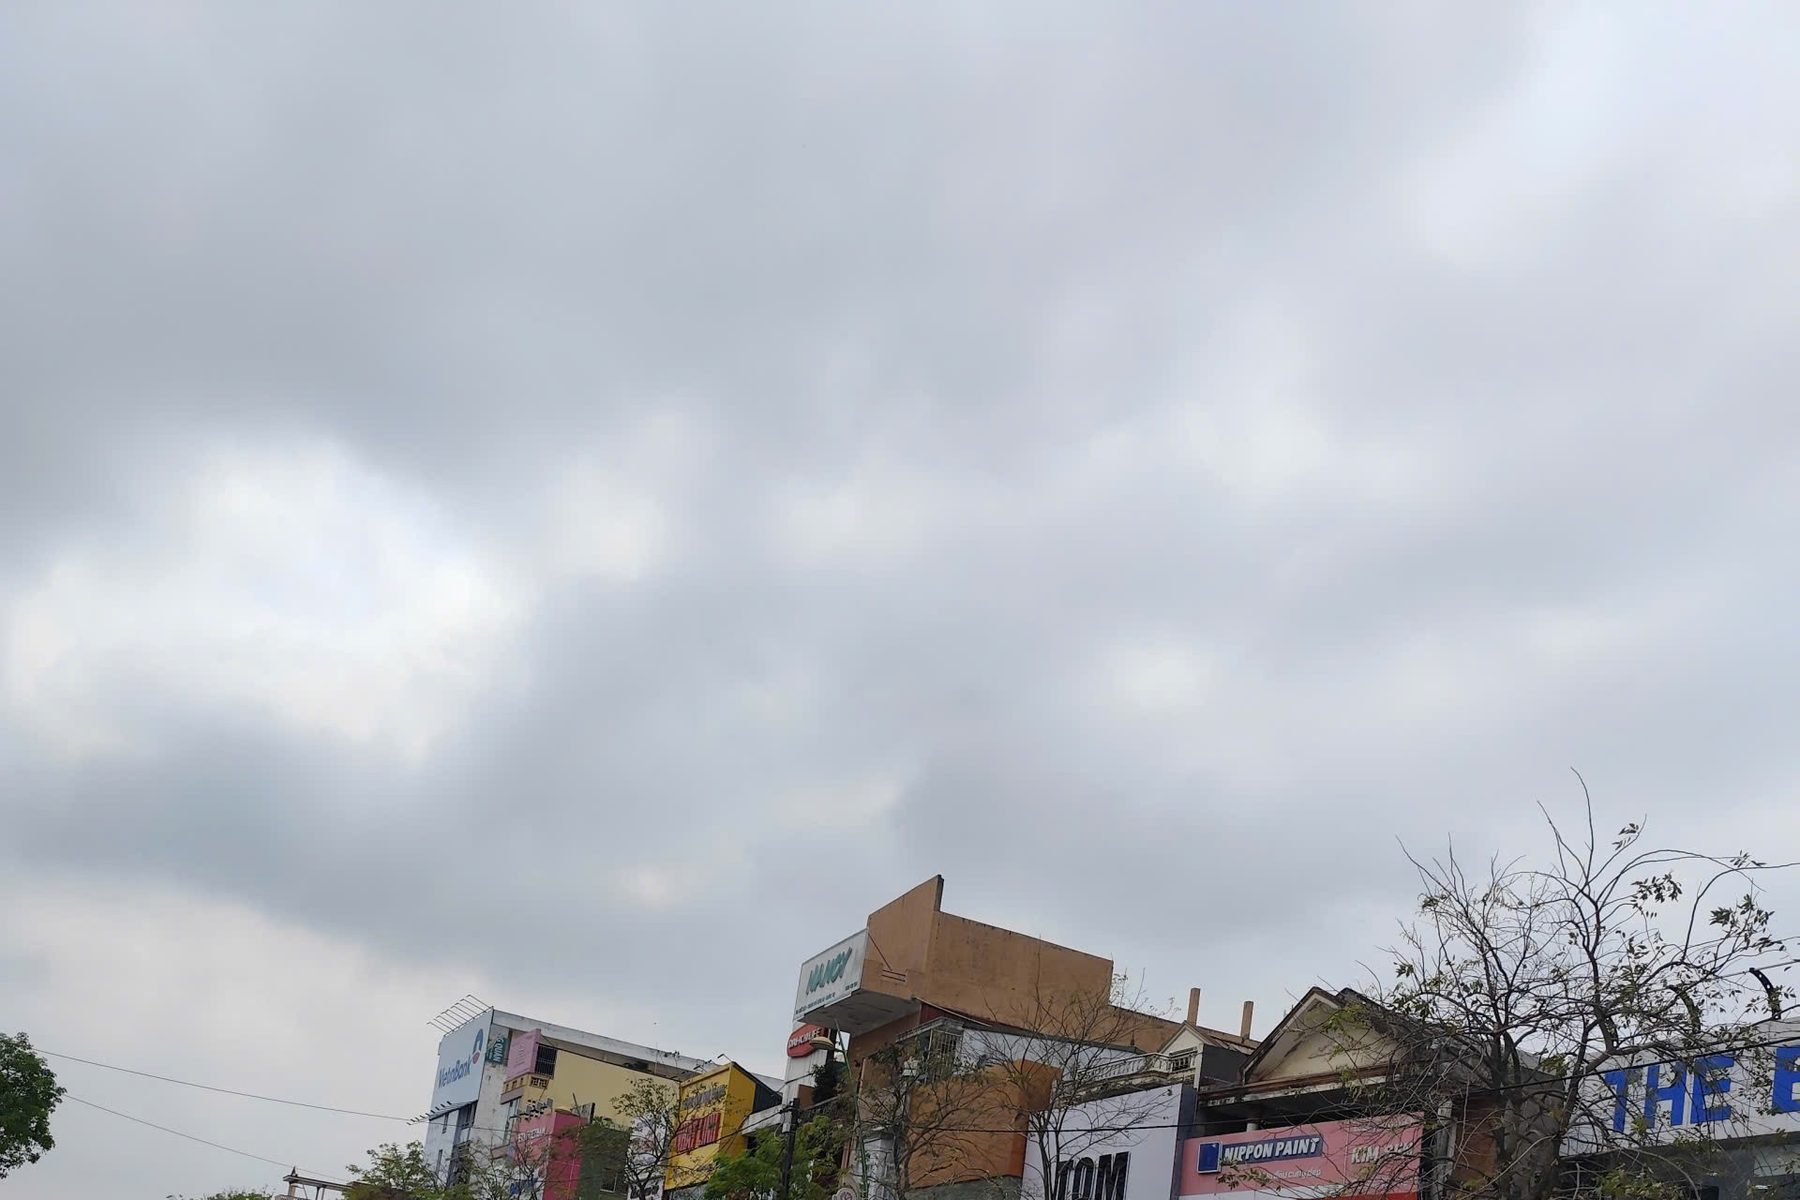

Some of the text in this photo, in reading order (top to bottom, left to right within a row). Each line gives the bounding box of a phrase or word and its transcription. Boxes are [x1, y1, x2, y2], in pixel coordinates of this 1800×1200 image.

[1605, 1056, 1735, 1133] THE
[1224, 1138, 1320, 1162] NIPPON PAINT
